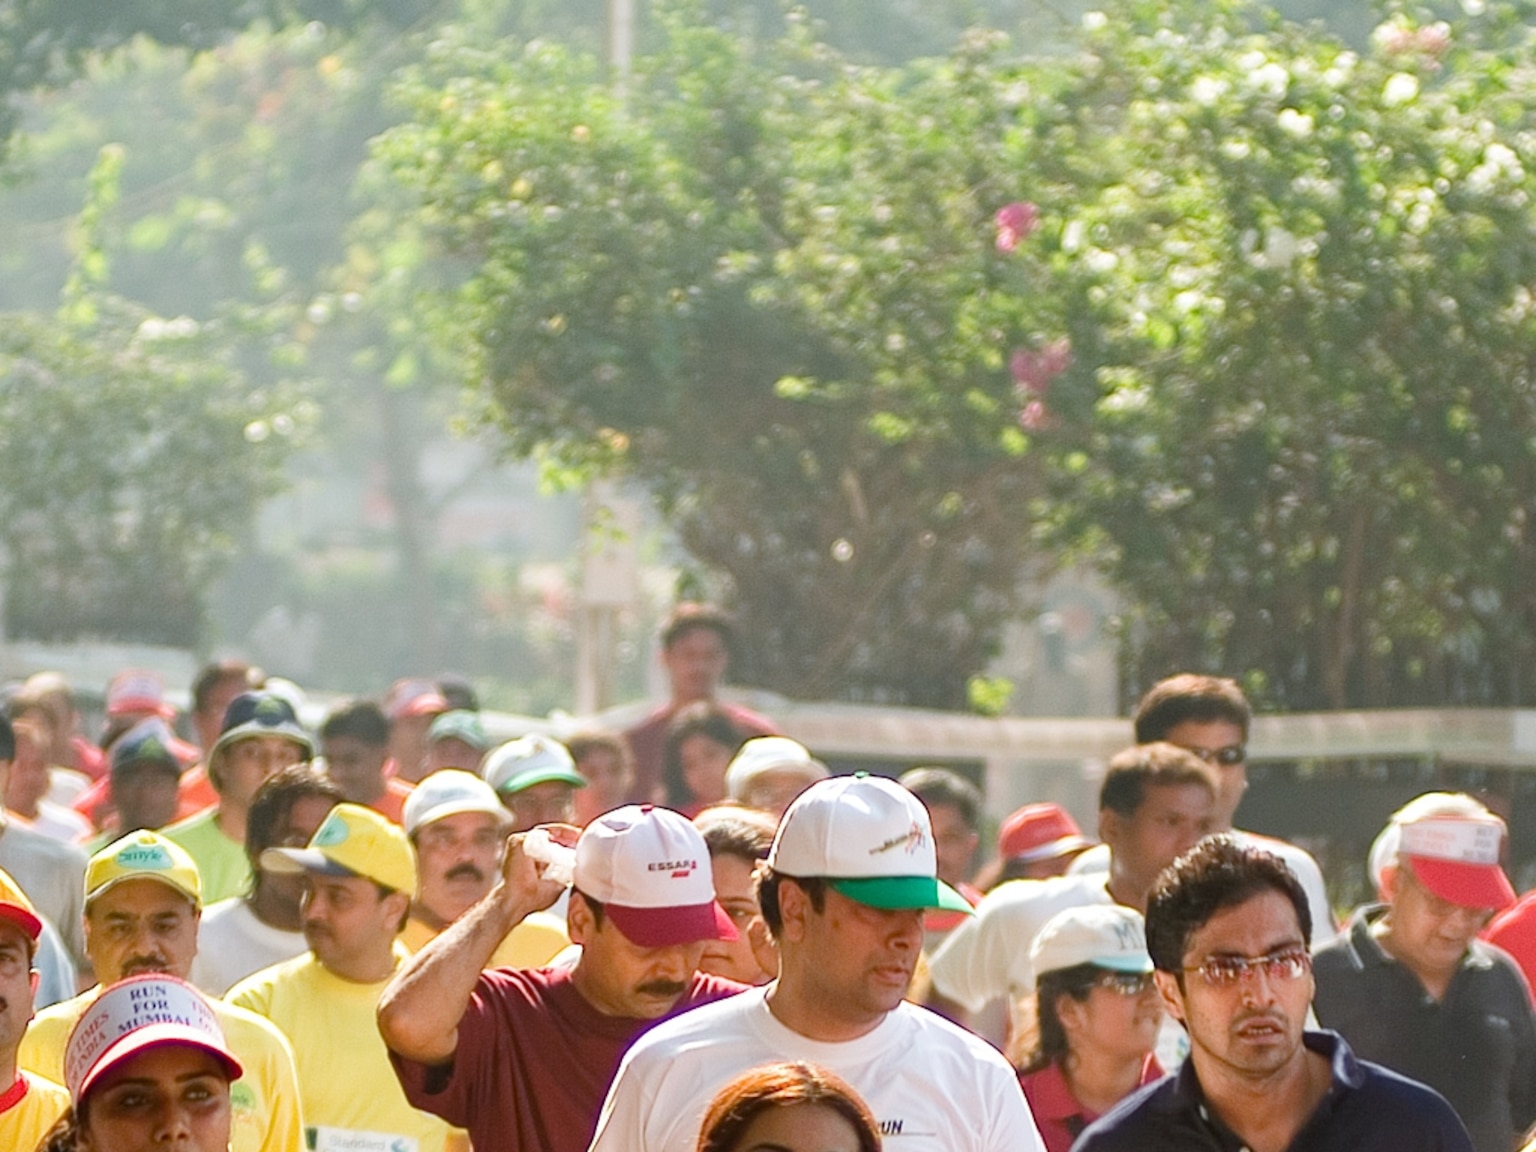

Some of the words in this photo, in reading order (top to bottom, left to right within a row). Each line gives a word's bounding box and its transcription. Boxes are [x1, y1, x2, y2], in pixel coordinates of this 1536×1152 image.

[648, 860, 690, 871] ESSAR
[129, 985, 167, 1000] RUN
[132, 1000, 170, 1014] FOR
[877, 1119, 904, 1135] UN
